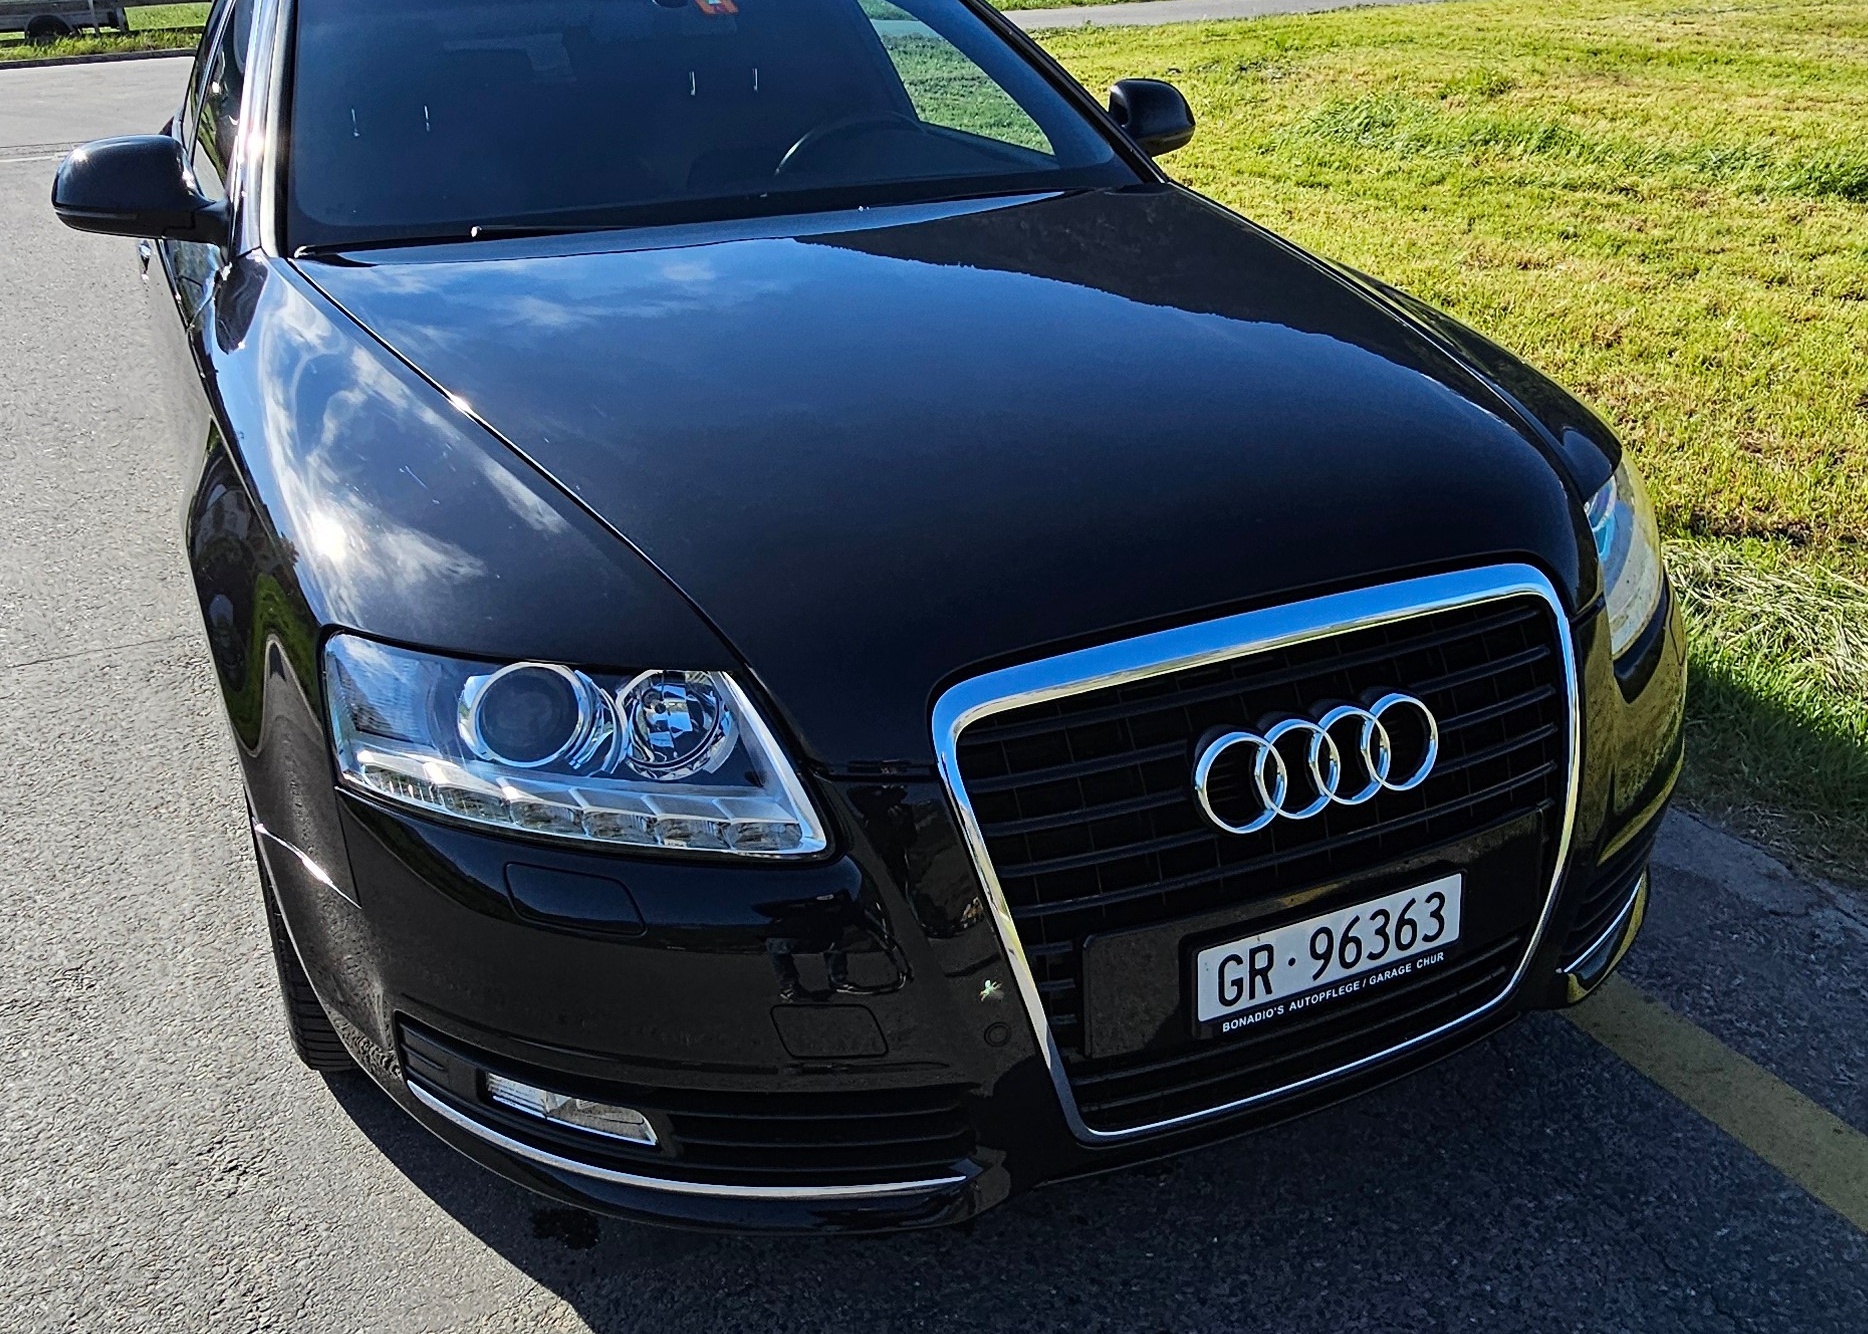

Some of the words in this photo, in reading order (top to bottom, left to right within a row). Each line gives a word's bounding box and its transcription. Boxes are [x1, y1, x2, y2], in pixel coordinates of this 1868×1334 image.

[1222, 1004, 1286, 1033] BONADIO'S
[1288, 981, 1361, 1012] AUTOPFLEGE
[1368, 962, 1413, 986] GARAGE
[1415, 951, 1445, 969] CHUR
